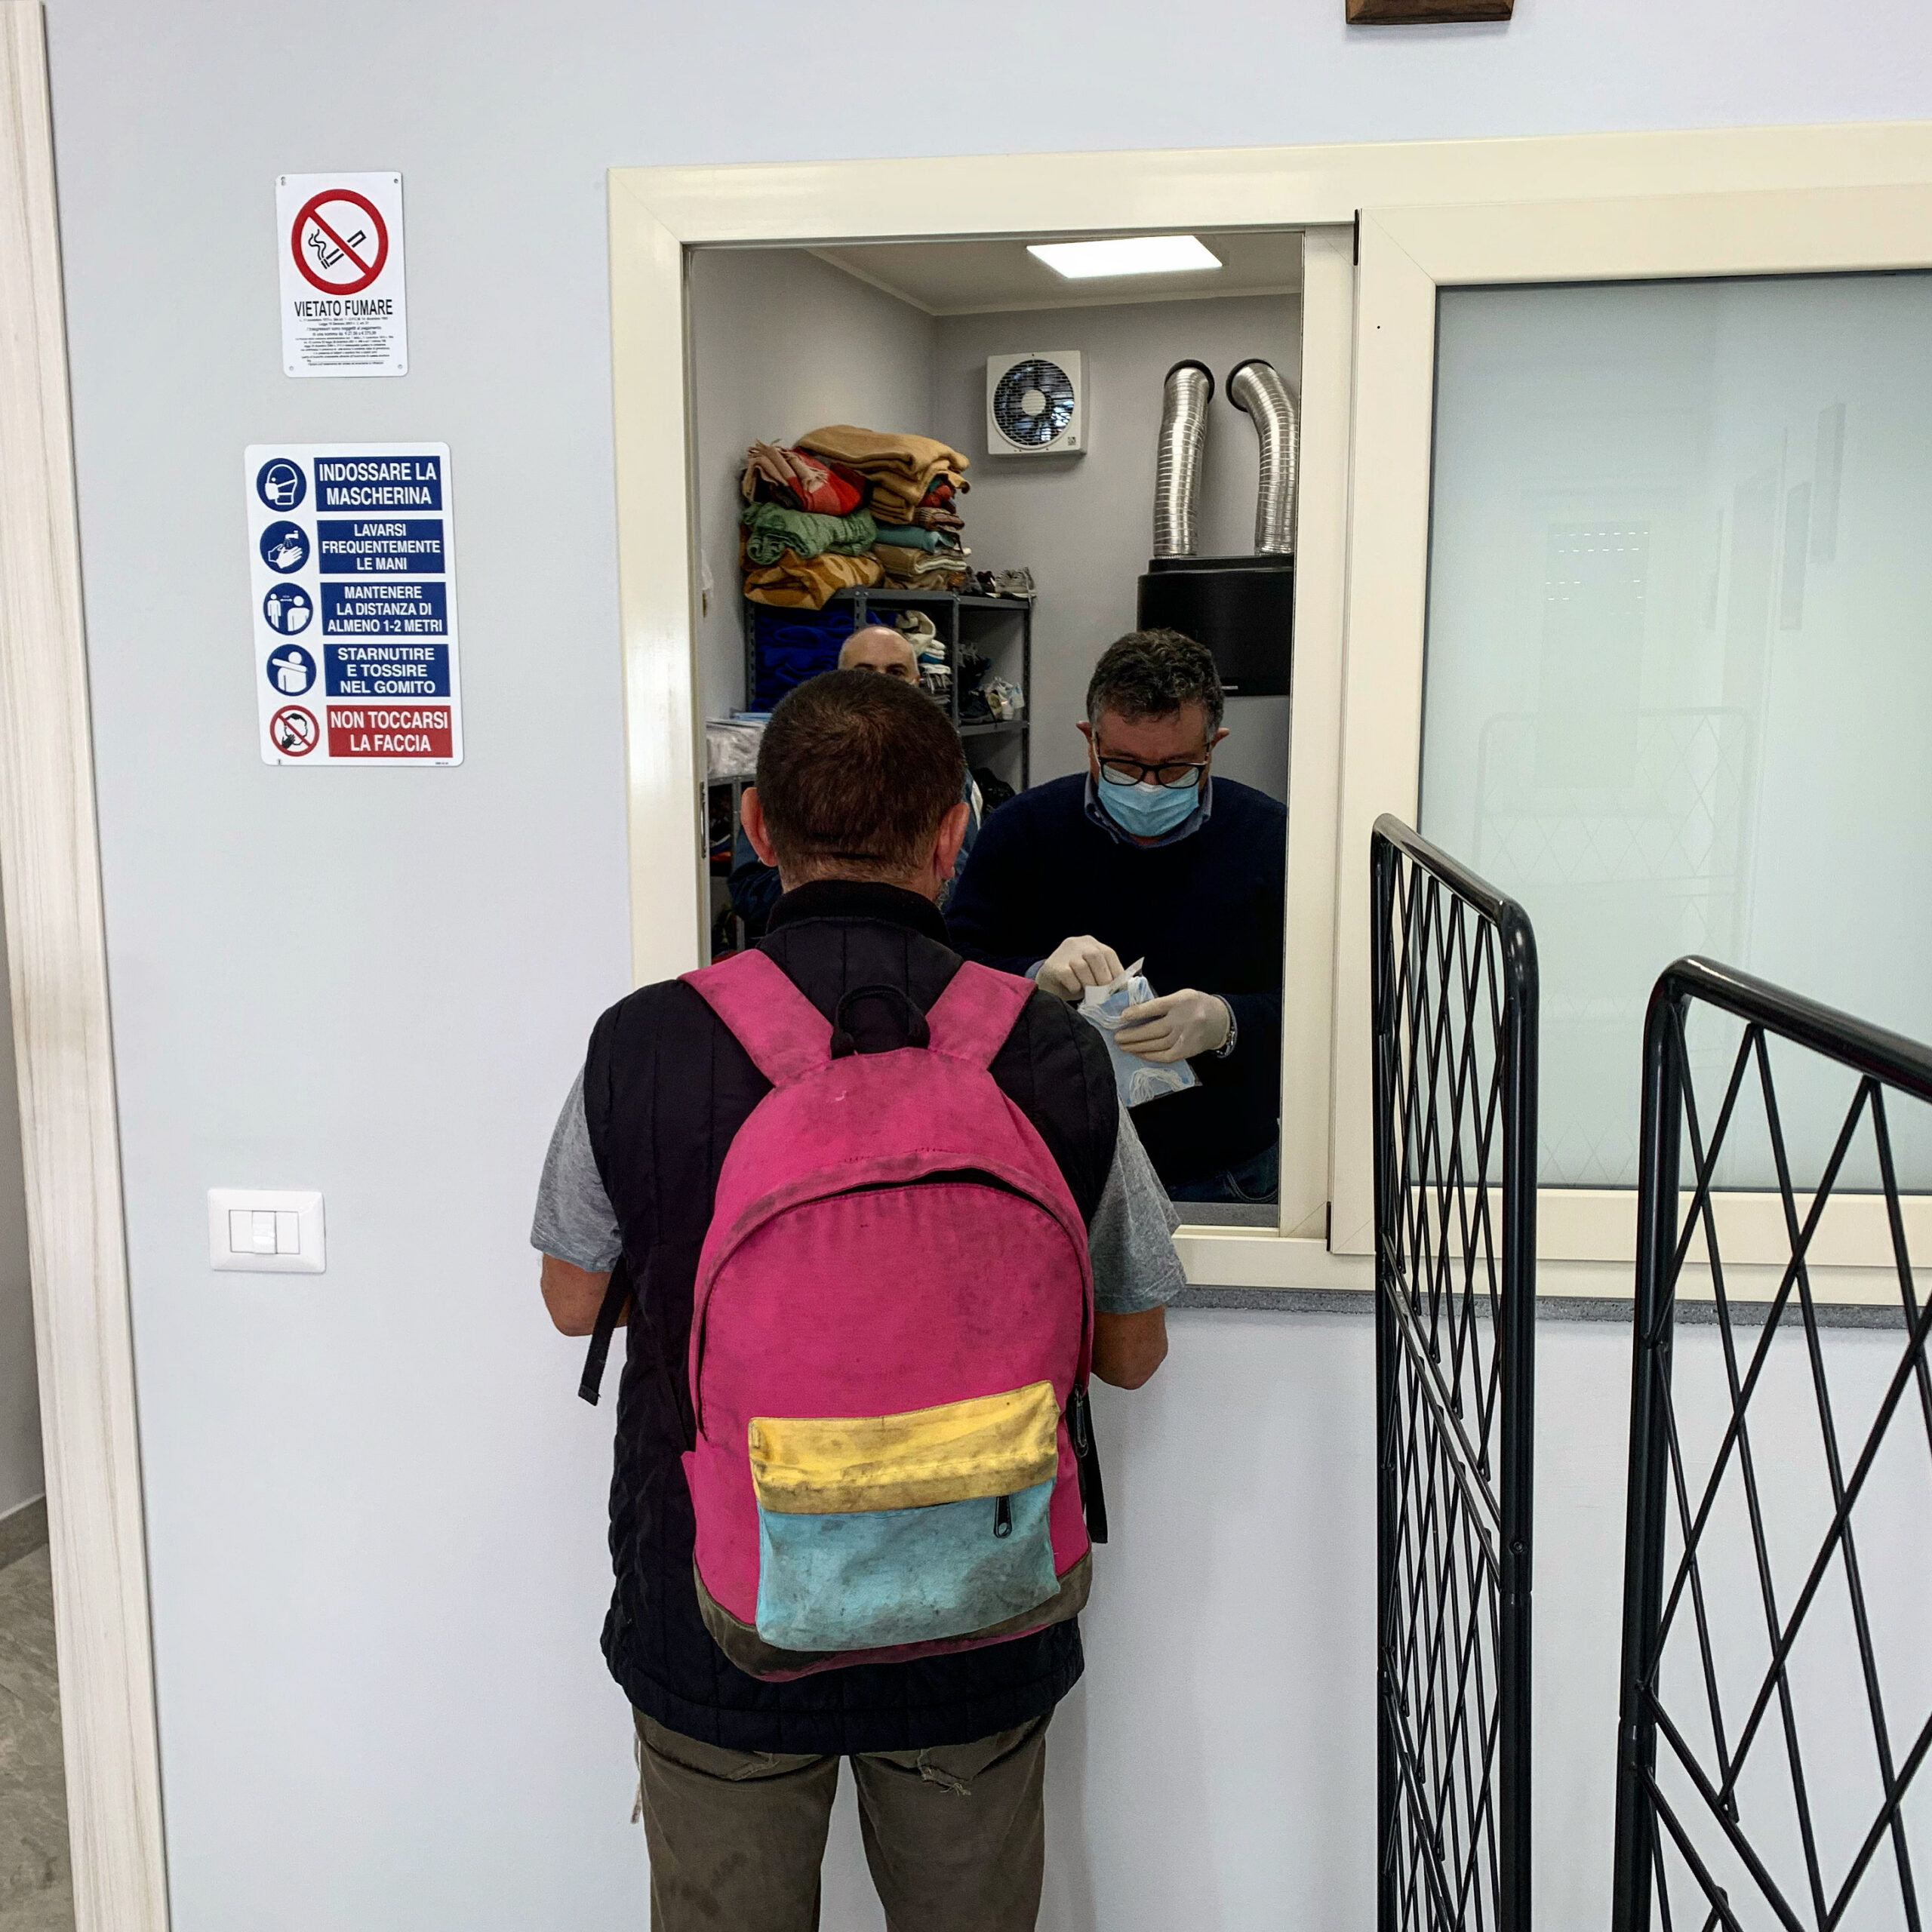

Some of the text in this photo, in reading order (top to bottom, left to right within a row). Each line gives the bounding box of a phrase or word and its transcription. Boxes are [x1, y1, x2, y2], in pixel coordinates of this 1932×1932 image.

[294, 299, 393, 316] VIETATO FUMARE
[319, 462, 437, 481] INDOSSARE LA
[326, 487, 432, 505] MASCHERINA
[354, 523, 407, 537] LAVARSI
[322, 540, 441, 554] FREQUENTEMENTE
[356, 557, 408, 570] LE MANI
[344, 586, 423, 599] MANTENERE
[336, 602, 432, 616] LA DISTANZA DI
[328, 619, 442, 632] ALMENO 1-2 METRI
[337, 647, 435, 660] STARNUTIRE
[346, 664, 428, 677] E TOSSIRE
[340, 680, 435, 694] NEL GOMITO
[330, 711, 448, 729] NON TOCCARSI
[350, 734, 432, 752] LA FACCIA
